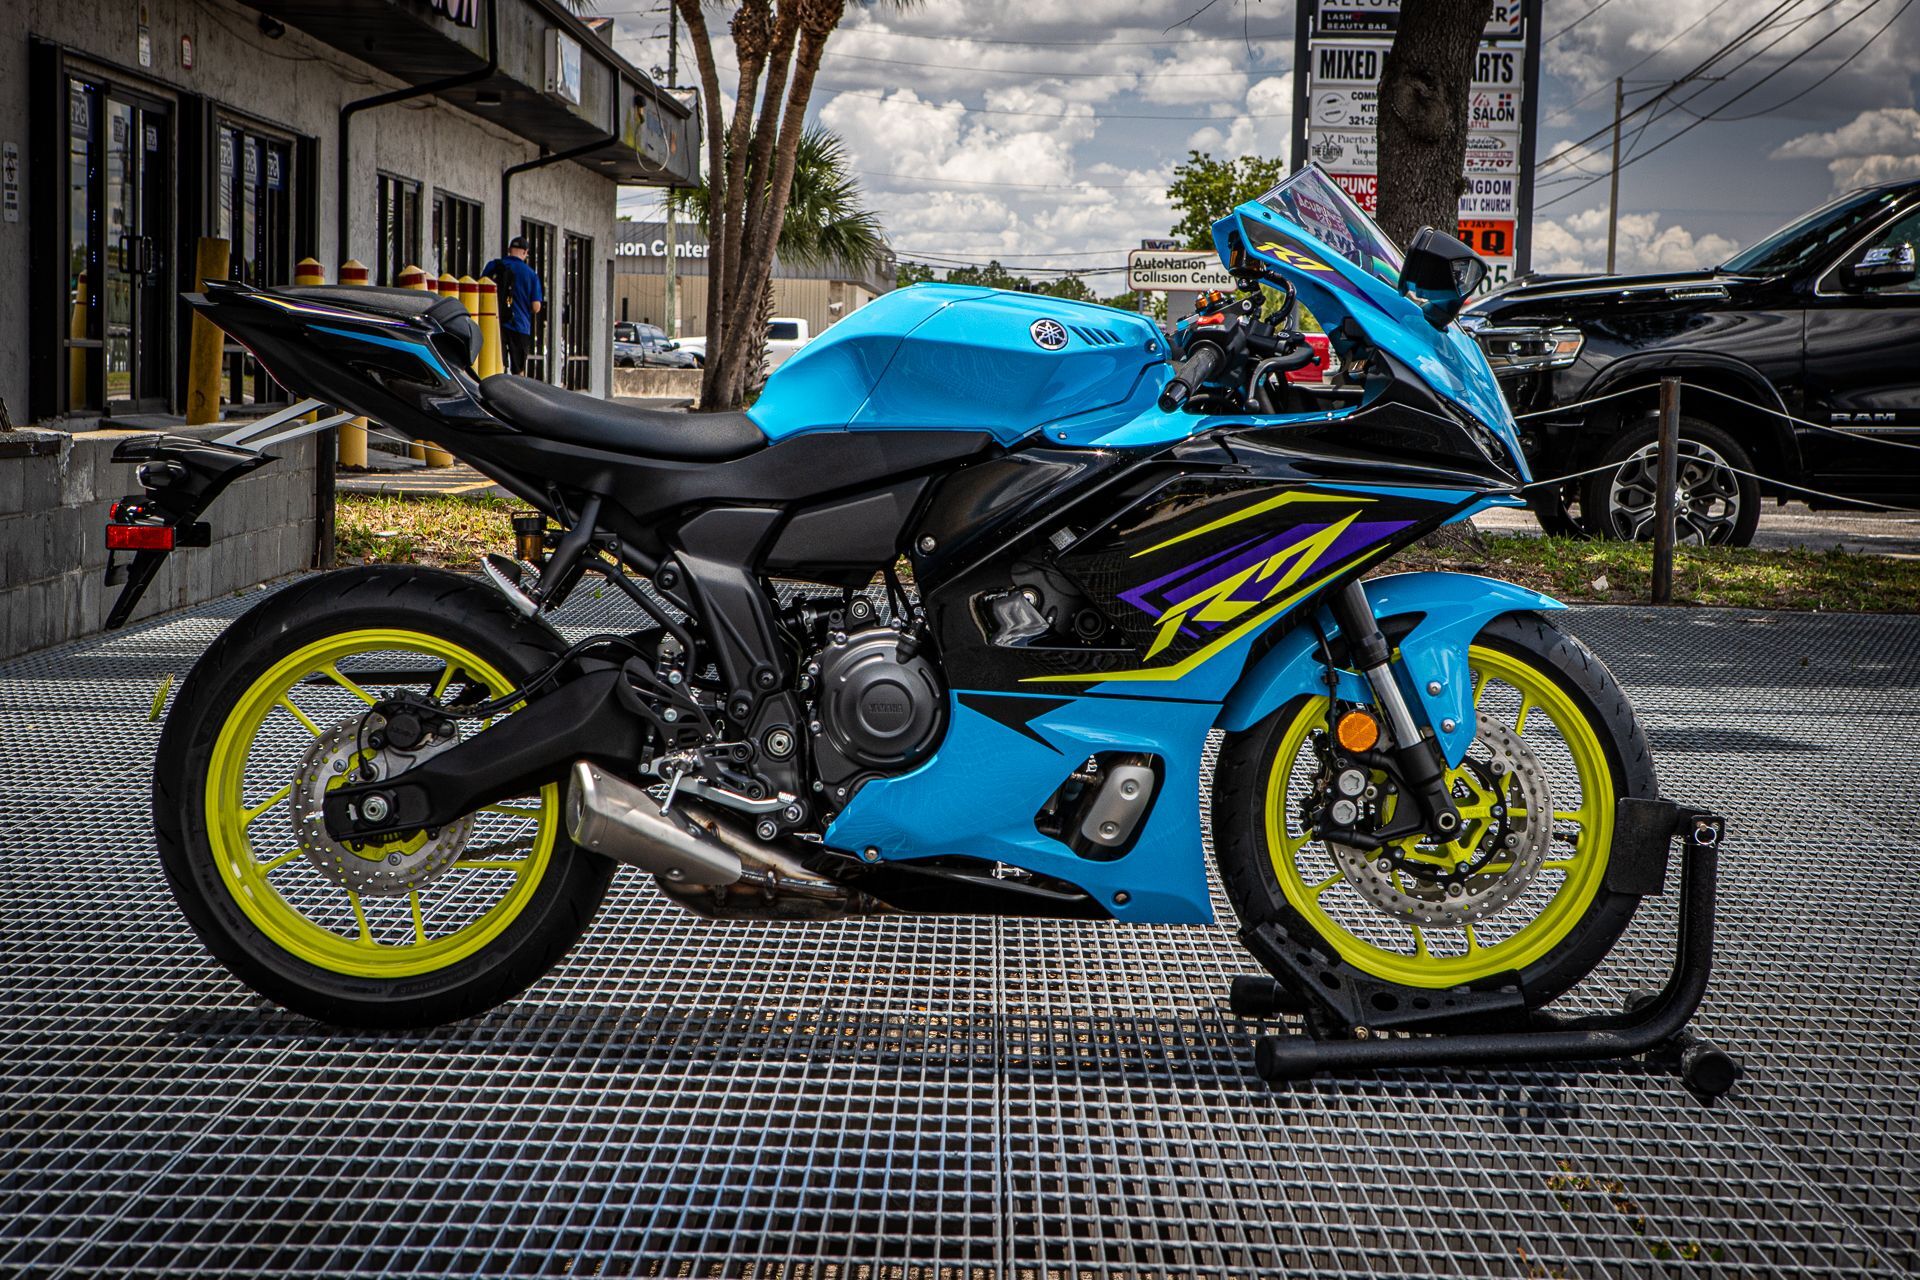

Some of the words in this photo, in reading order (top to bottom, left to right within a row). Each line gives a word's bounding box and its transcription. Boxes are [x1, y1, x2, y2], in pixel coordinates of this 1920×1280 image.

[1319, 49, 1378, 79] MIXED
[1361, 103, 1377, 112] KIT
[1473, 107, 1515, 122] SALON
[1338, 134, 1369, 144] Puerto
[1352, 158, 1377, 166] Kitche
[1480, 198, 1511, 212] CHURCH
[1134, 257, 1206, 270] AutoNation
[1133, 271, 1187, 284] Collision
[1191, 272, 1232, 284] Center
[1831, 412, 1897, 422] RAM
[869, 703, 903, 713] YAMAHA
